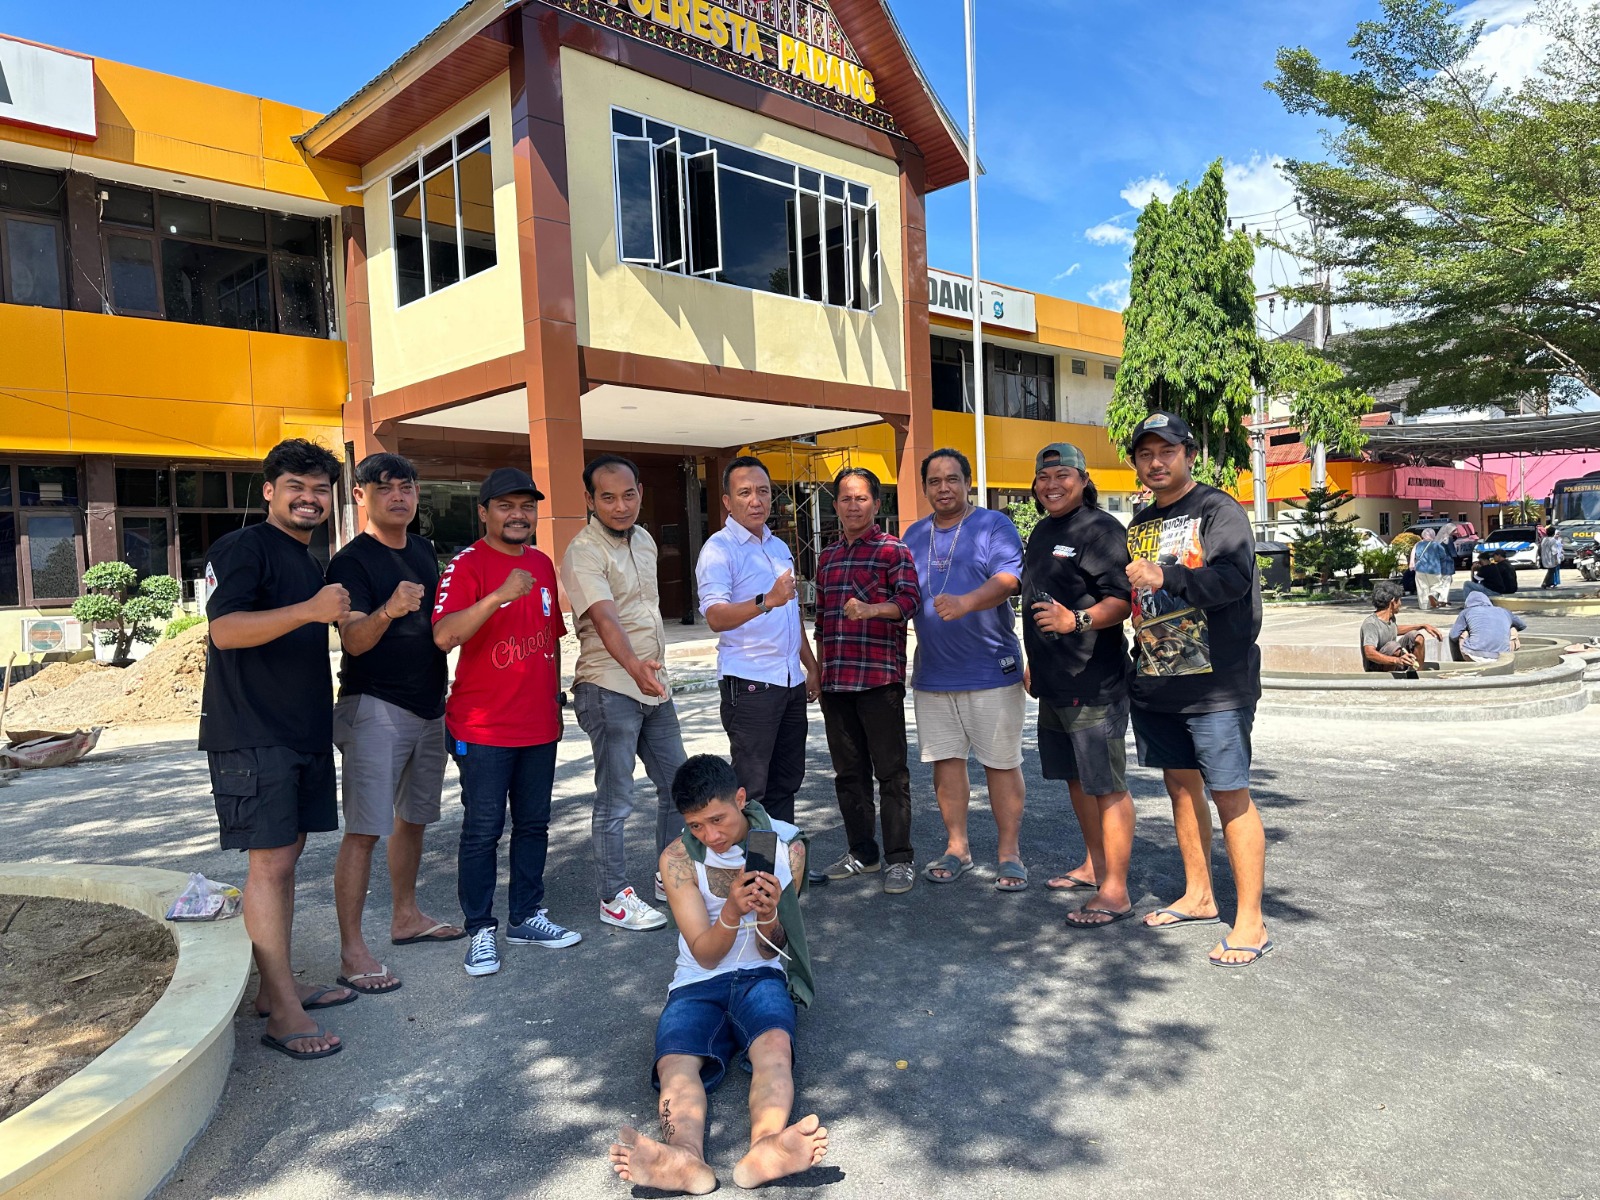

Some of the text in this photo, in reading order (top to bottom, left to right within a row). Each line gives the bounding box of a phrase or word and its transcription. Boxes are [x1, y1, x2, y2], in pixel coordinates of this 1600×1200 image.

[607, 0, 876, 105] LRESTA PADANG
[491, 624, 552, 669] Chicag
